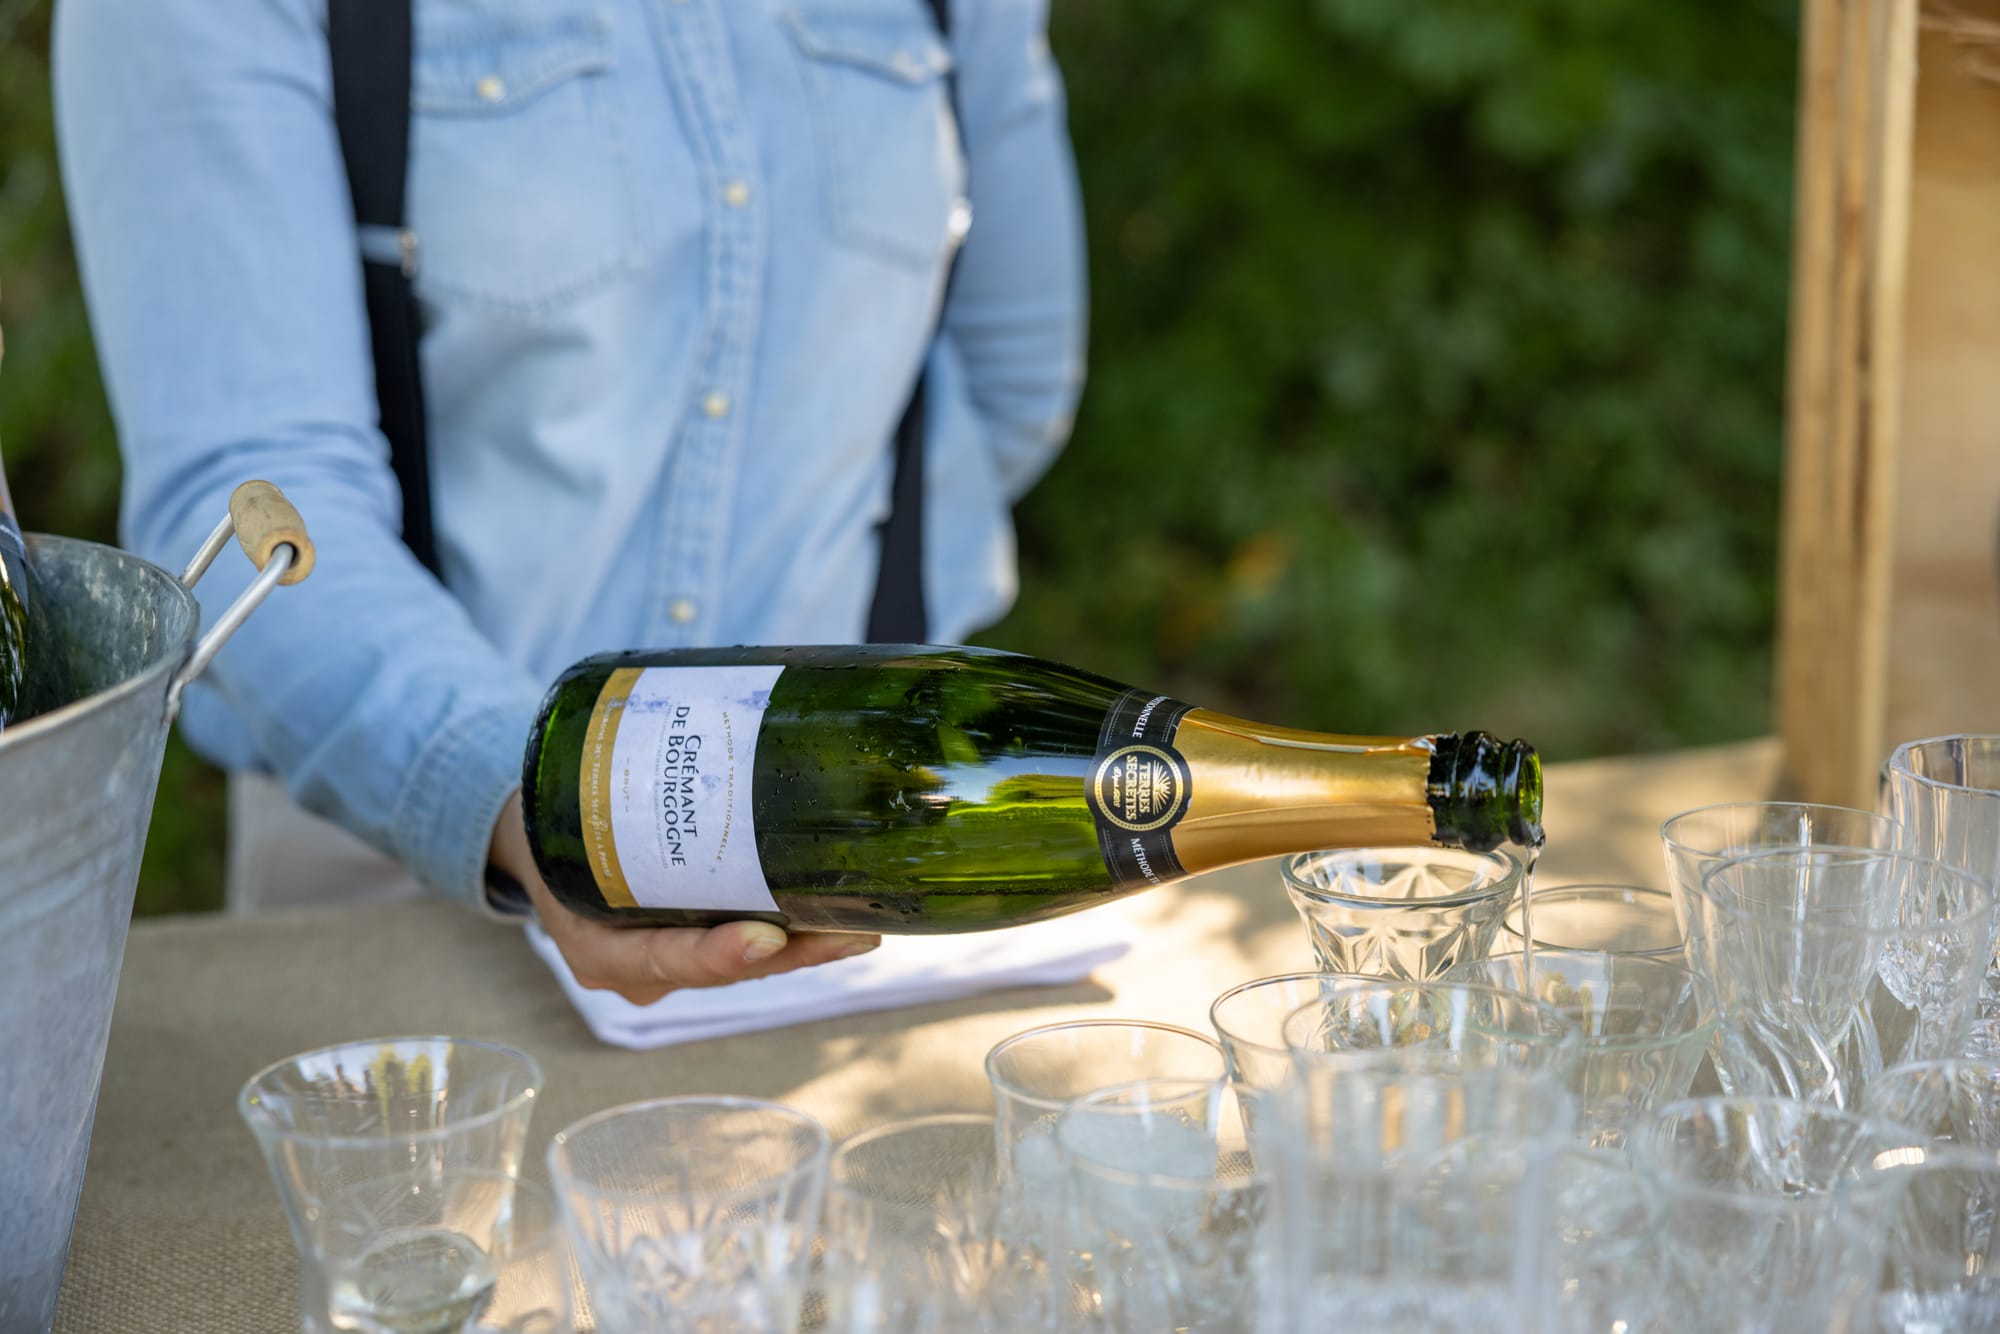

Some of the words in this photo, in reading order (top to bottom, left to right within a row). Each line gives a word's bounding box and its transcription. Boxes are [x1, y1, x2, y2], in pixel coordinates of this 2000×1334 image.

[672, 706, 690, 729] DE
[663, 735, 686, 867] BOURGOGNE
[681, 735, 701, 838] CRÉMANT
[716, 767, 735, 862] TRADITIONNELLE
[1126, 755, 1139, 820] SECRÈTES
[1139, 762, 1151, 814] TERRES
[1131, 838, 1155, 878] MÉTHODE
